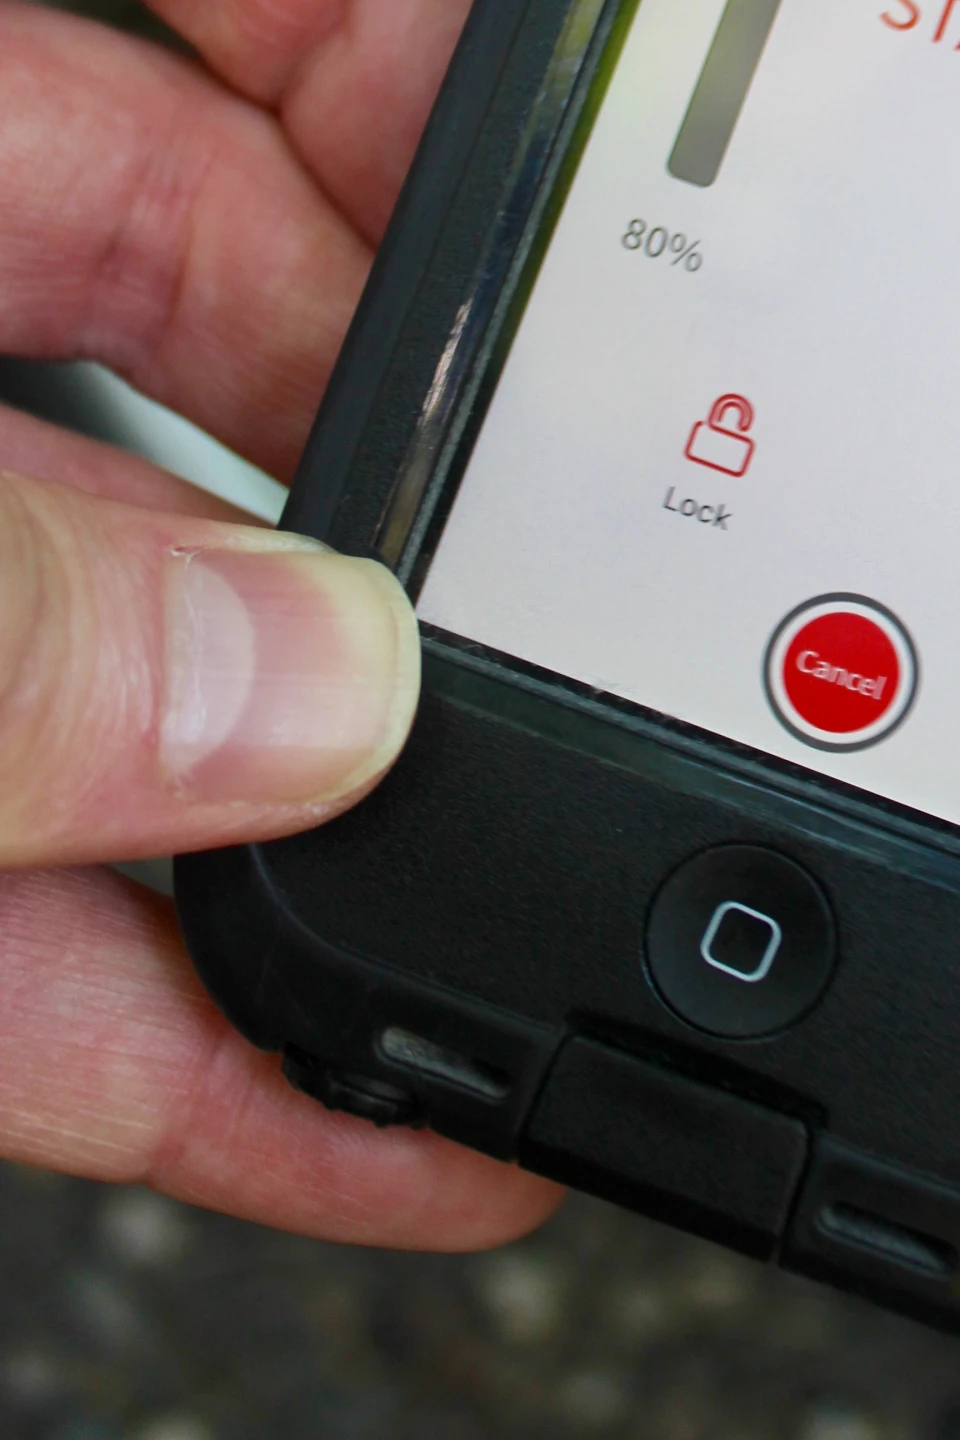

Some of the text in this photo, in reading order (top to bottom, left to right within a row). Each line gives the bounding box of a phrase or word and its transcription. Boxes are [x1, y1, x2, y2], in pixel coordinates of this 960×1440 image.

[620, 217, 706, 274] 80%
[662, 485, 733, 531] Lock
[796, 648, 888, 702] Cancel
